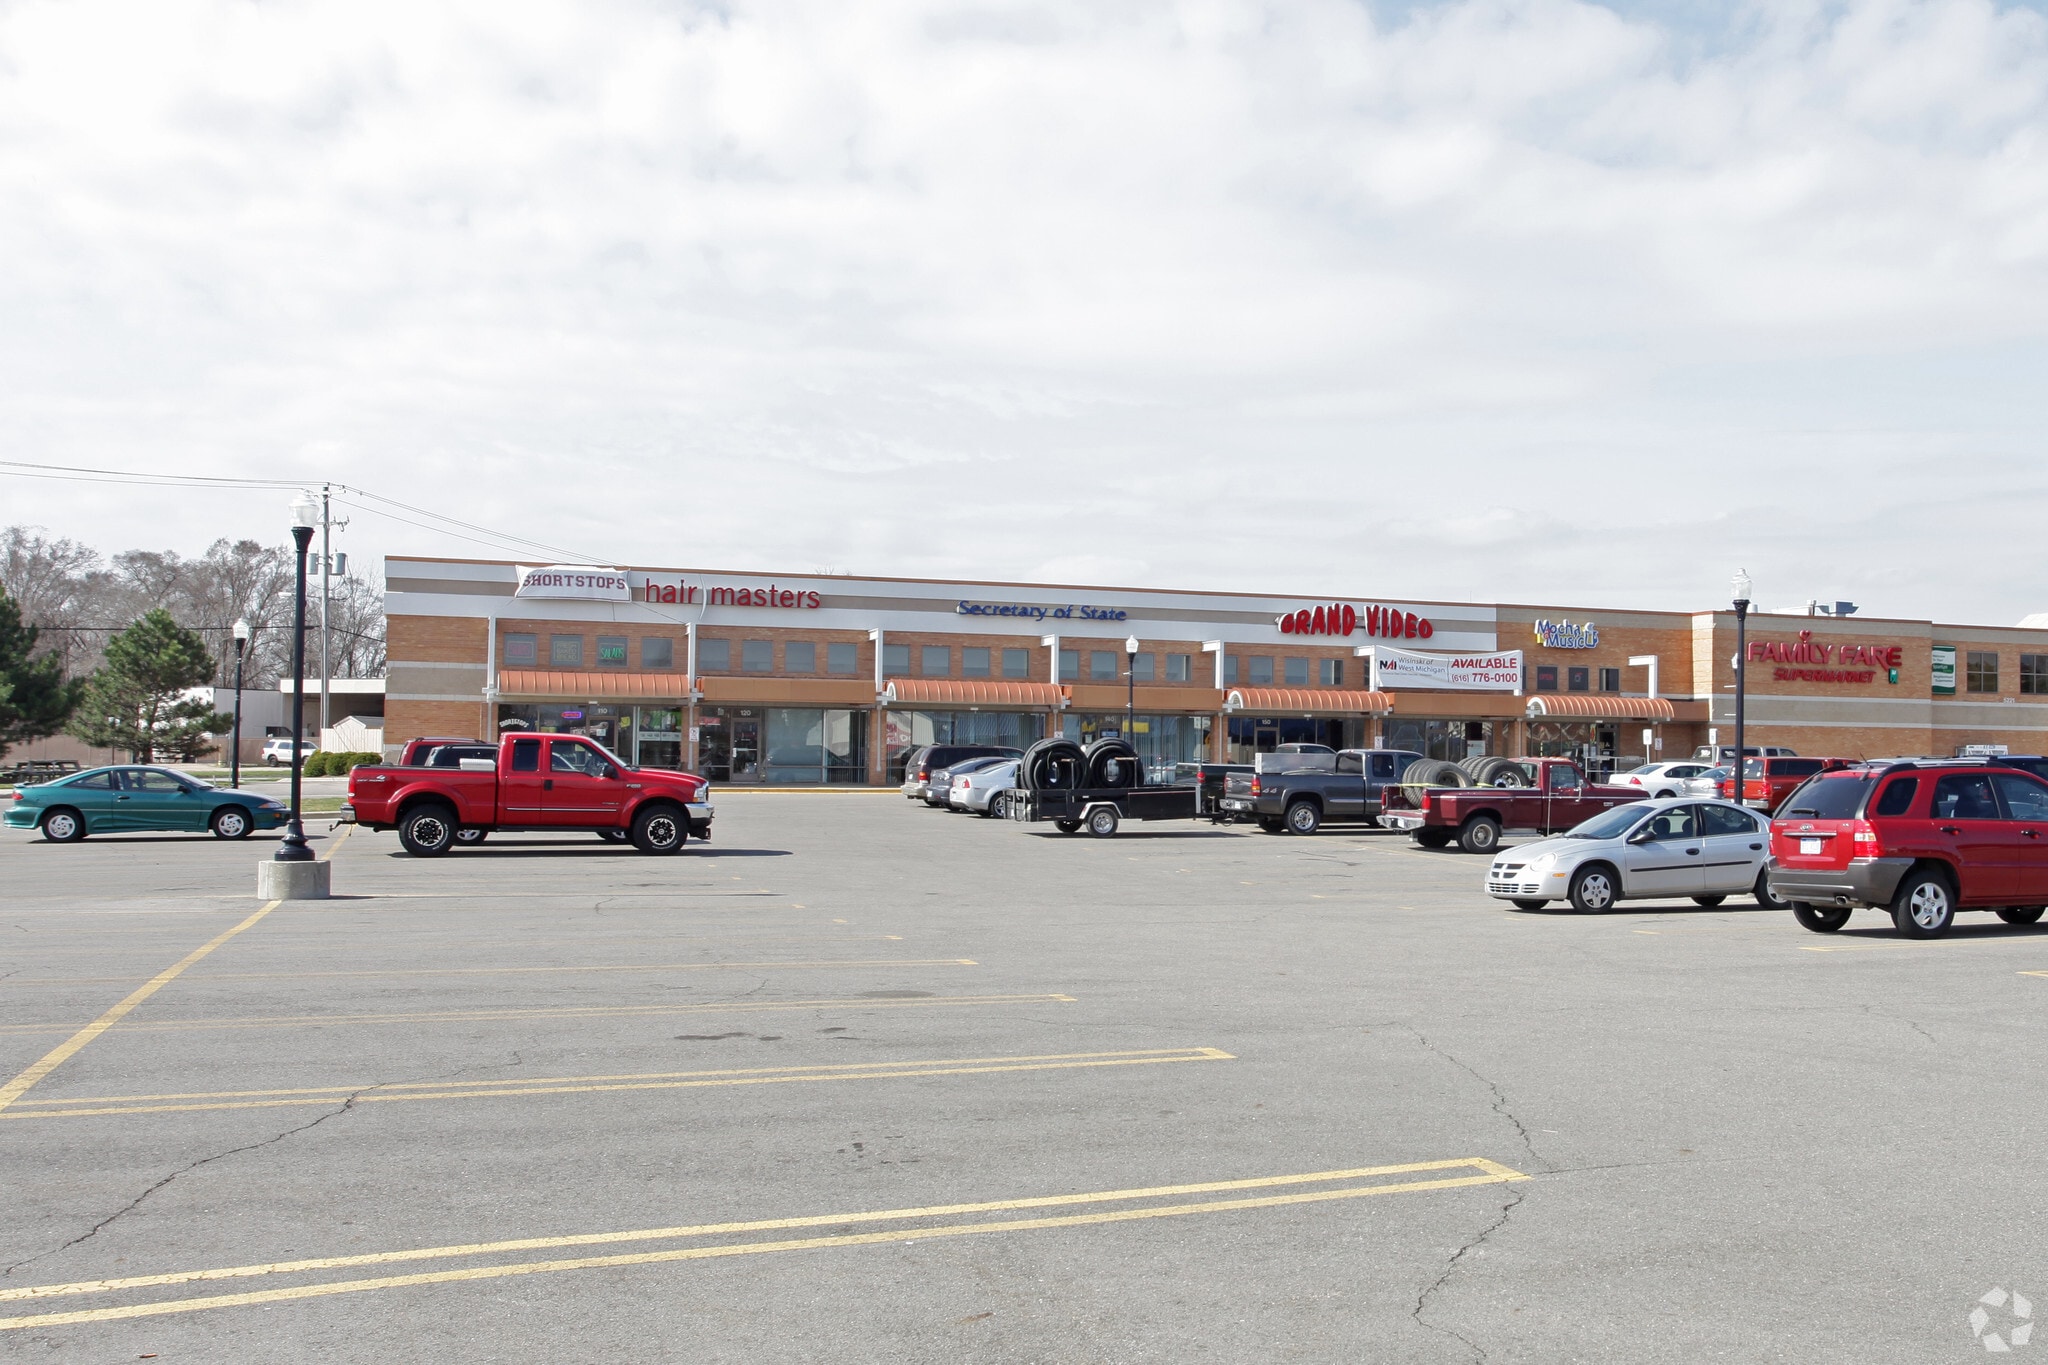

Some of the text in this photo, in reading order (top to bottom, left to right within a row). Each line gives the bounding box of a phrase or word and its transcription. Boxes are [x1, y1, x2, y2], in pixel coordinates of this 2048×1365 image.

[523, 574, 626, 590] SHORTSTOPS
[645, 578, 821, 609] hair masters
[957, 600, 1127, 621] Secretary of State
[1279, 603, 1434, 639] GRAND VIDEO
[1535, 619, 1582, 634] Mocha
[1544, 633, 1586, 648] Music
[1451, 658, 1518, 669] AVAILABLE
[1748, 641, 1903, 672] FAMILY FARE
[1379, 659, 1397, 670] NAI
[1416, 666, 1446, 674] Michigan
[1451, 672, 1518, 683] (616) 776-0100
[1773, 667, 1877, 684] SUPERMARKET
